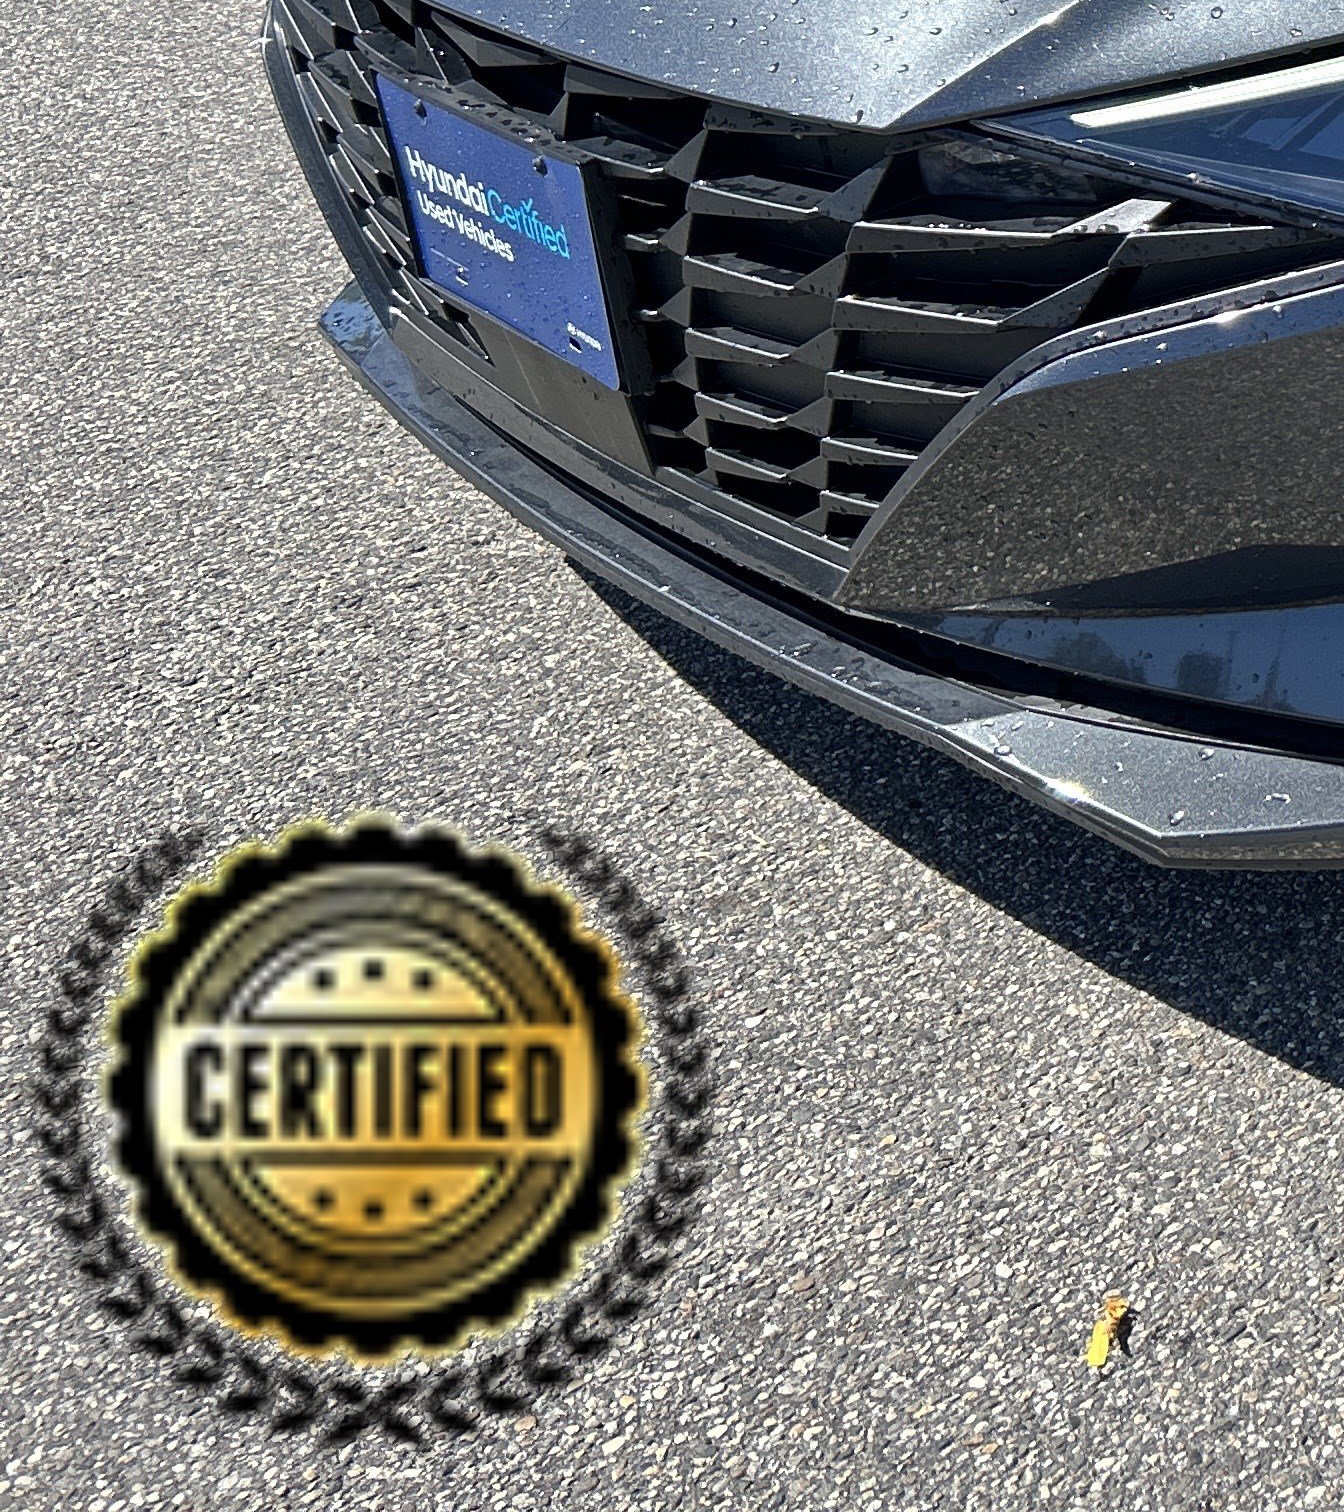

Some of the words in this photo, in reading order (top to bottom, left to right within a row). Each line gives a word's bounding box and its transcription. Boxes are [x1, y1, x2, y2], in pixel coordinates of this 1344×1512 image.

[404, 146, 490, 217] Hyundai
[417, 189, 456, 230] Used
[452, 208, 515, 262] Vehicles
